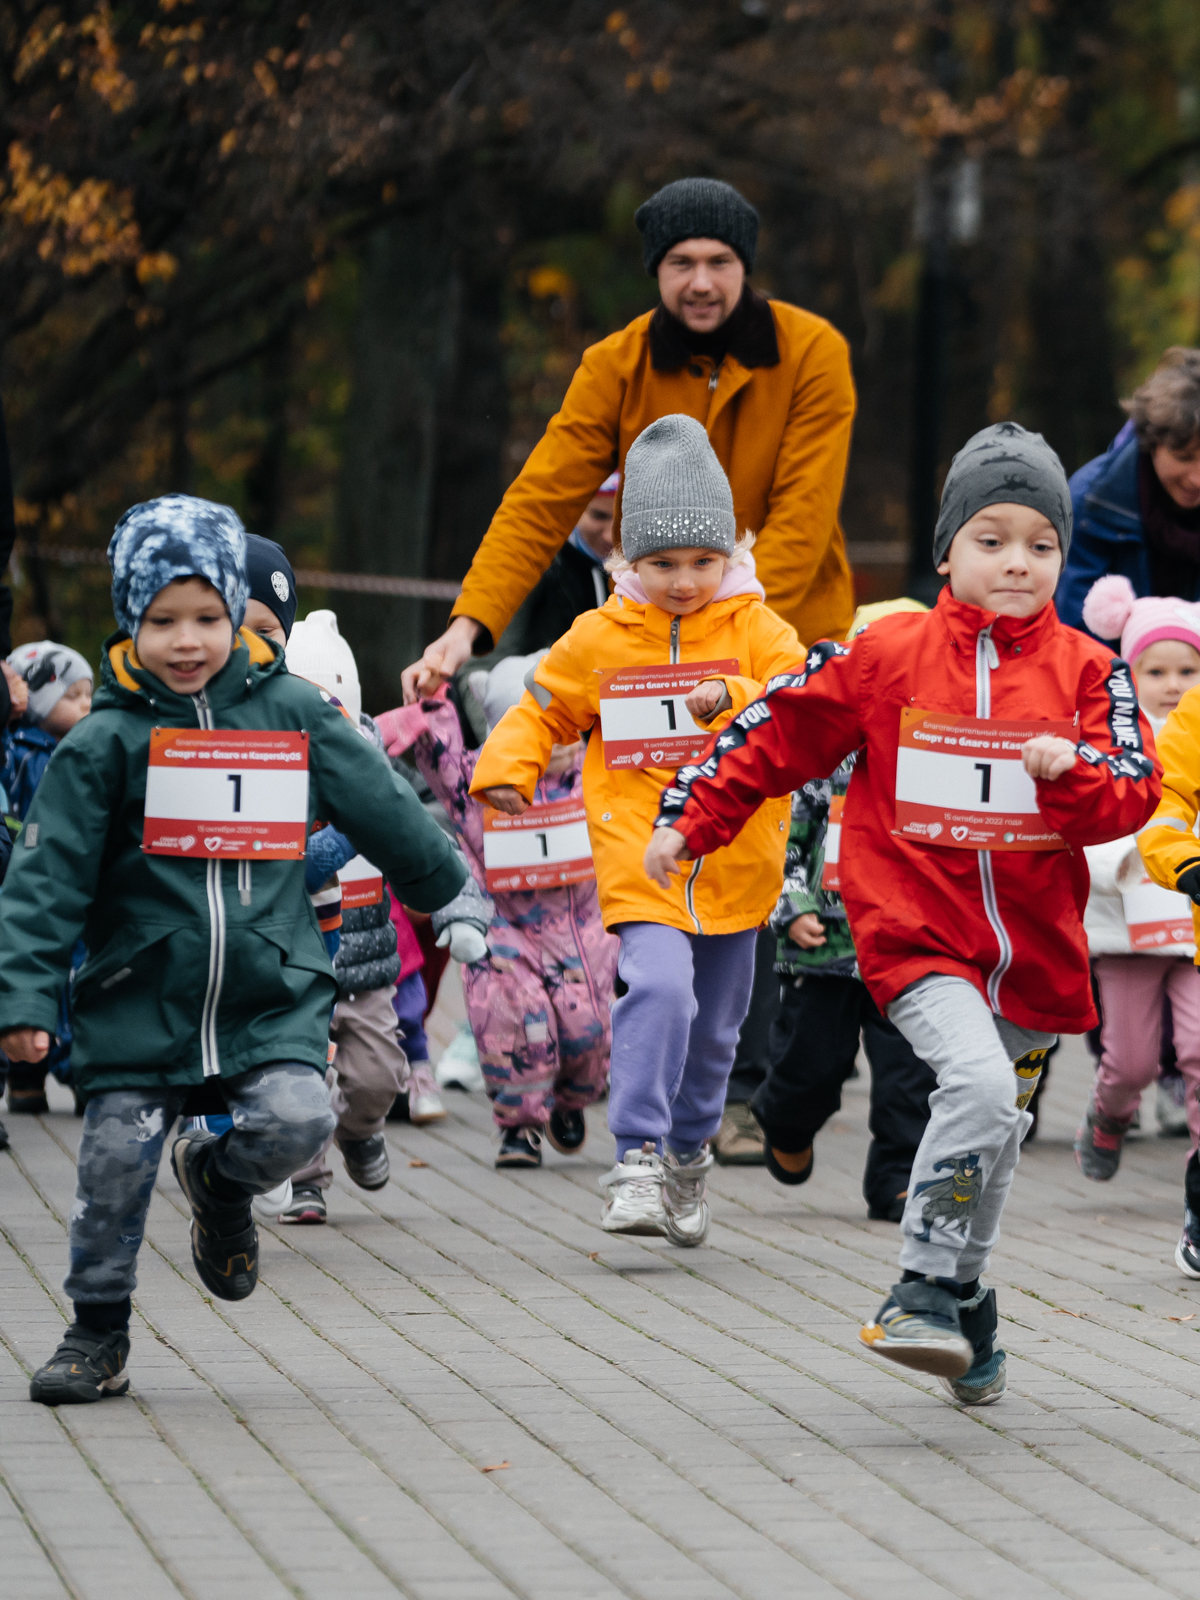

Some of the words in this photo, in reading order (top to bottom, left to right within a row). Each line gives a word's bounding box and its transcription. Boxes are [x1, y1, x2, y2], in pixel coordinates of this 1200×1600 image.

[675, 670, 702, 678] осенний
[703, 668, 720, 676] забег
[609, 683, 634, 692] Спорт
[646, 681, 670, 690] благо
[1108, 668, 1133, 698] YOU
[661, 699, 677, 731] 1
[735, 701, 771, 729] YOU
[1111, 701, 1140, 748] NAME
[912, 730, 943, 745] Спорт
[944, 737, 957, 745] во
[958, 736, 991, 749] благо
[922, 721, 998, 738] Благотворительный
[998, 731, 1034, 739] осенний
[650, 741, 674, 749] октября
[690, 739, 704, 747] года
[164, 748, 196, 760] Спорт
[212, 750, 240, 759] благо
[249, 752, 303, 762] KasperskyOS
[974, 763, 992, 803] 1
[226, 774, 242, 813] 1
[943, 812, 952, 821] 15
[952, 815, 984, 825] октября
[984, 817, 1004, 826] 2022
[1004, 818, 1023, 826] года
[205, 825, 235, 834] октября
[236, 826, 252, 834] 2022
[535, 832, 548, 858] 1
